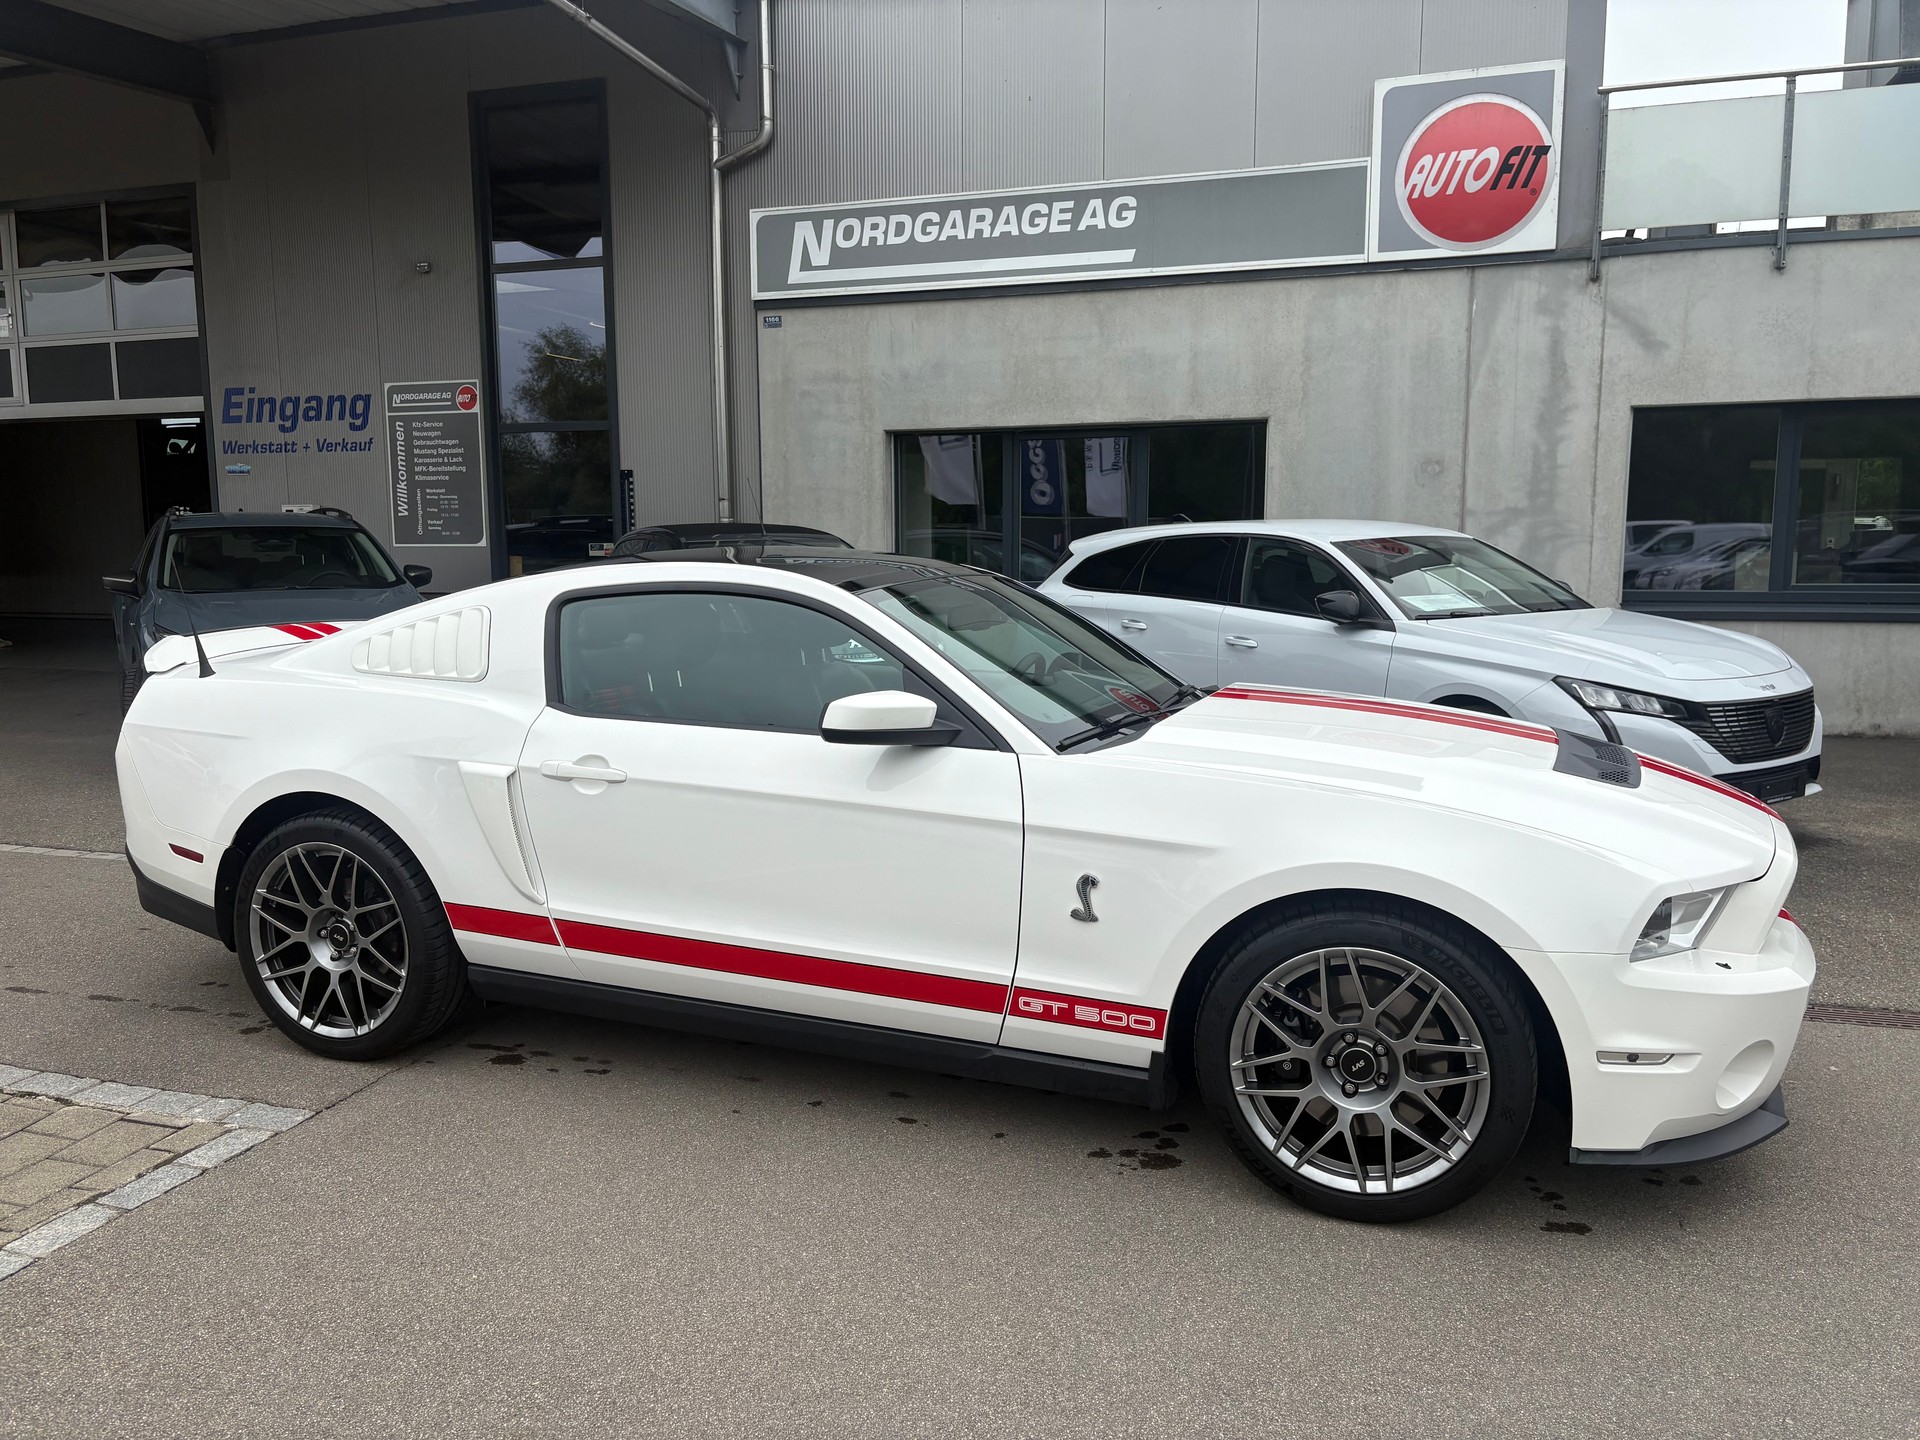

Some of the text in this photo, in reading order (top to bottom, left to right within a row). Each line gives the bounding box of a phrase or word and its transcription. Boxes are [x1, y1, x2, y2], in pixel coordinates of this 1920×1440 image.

[1405, 145, 1552, 199] AUTOFIT
[791, 196, 1137, 267] NORDGARAGE AG
[222, 387, 372, 433] Eingang
[392, 393, 441, 404] NORDGARAGE
[222, 438, 374, 455] Werkstatt + Verkauf
[396, 421, 408, 516] Willkommen
[1018, 996, 1156, 1031] GT 500
[1427, 947, 1507, 1034] MICHELIN
[1351, 1059, 1366, 1072] SVT
